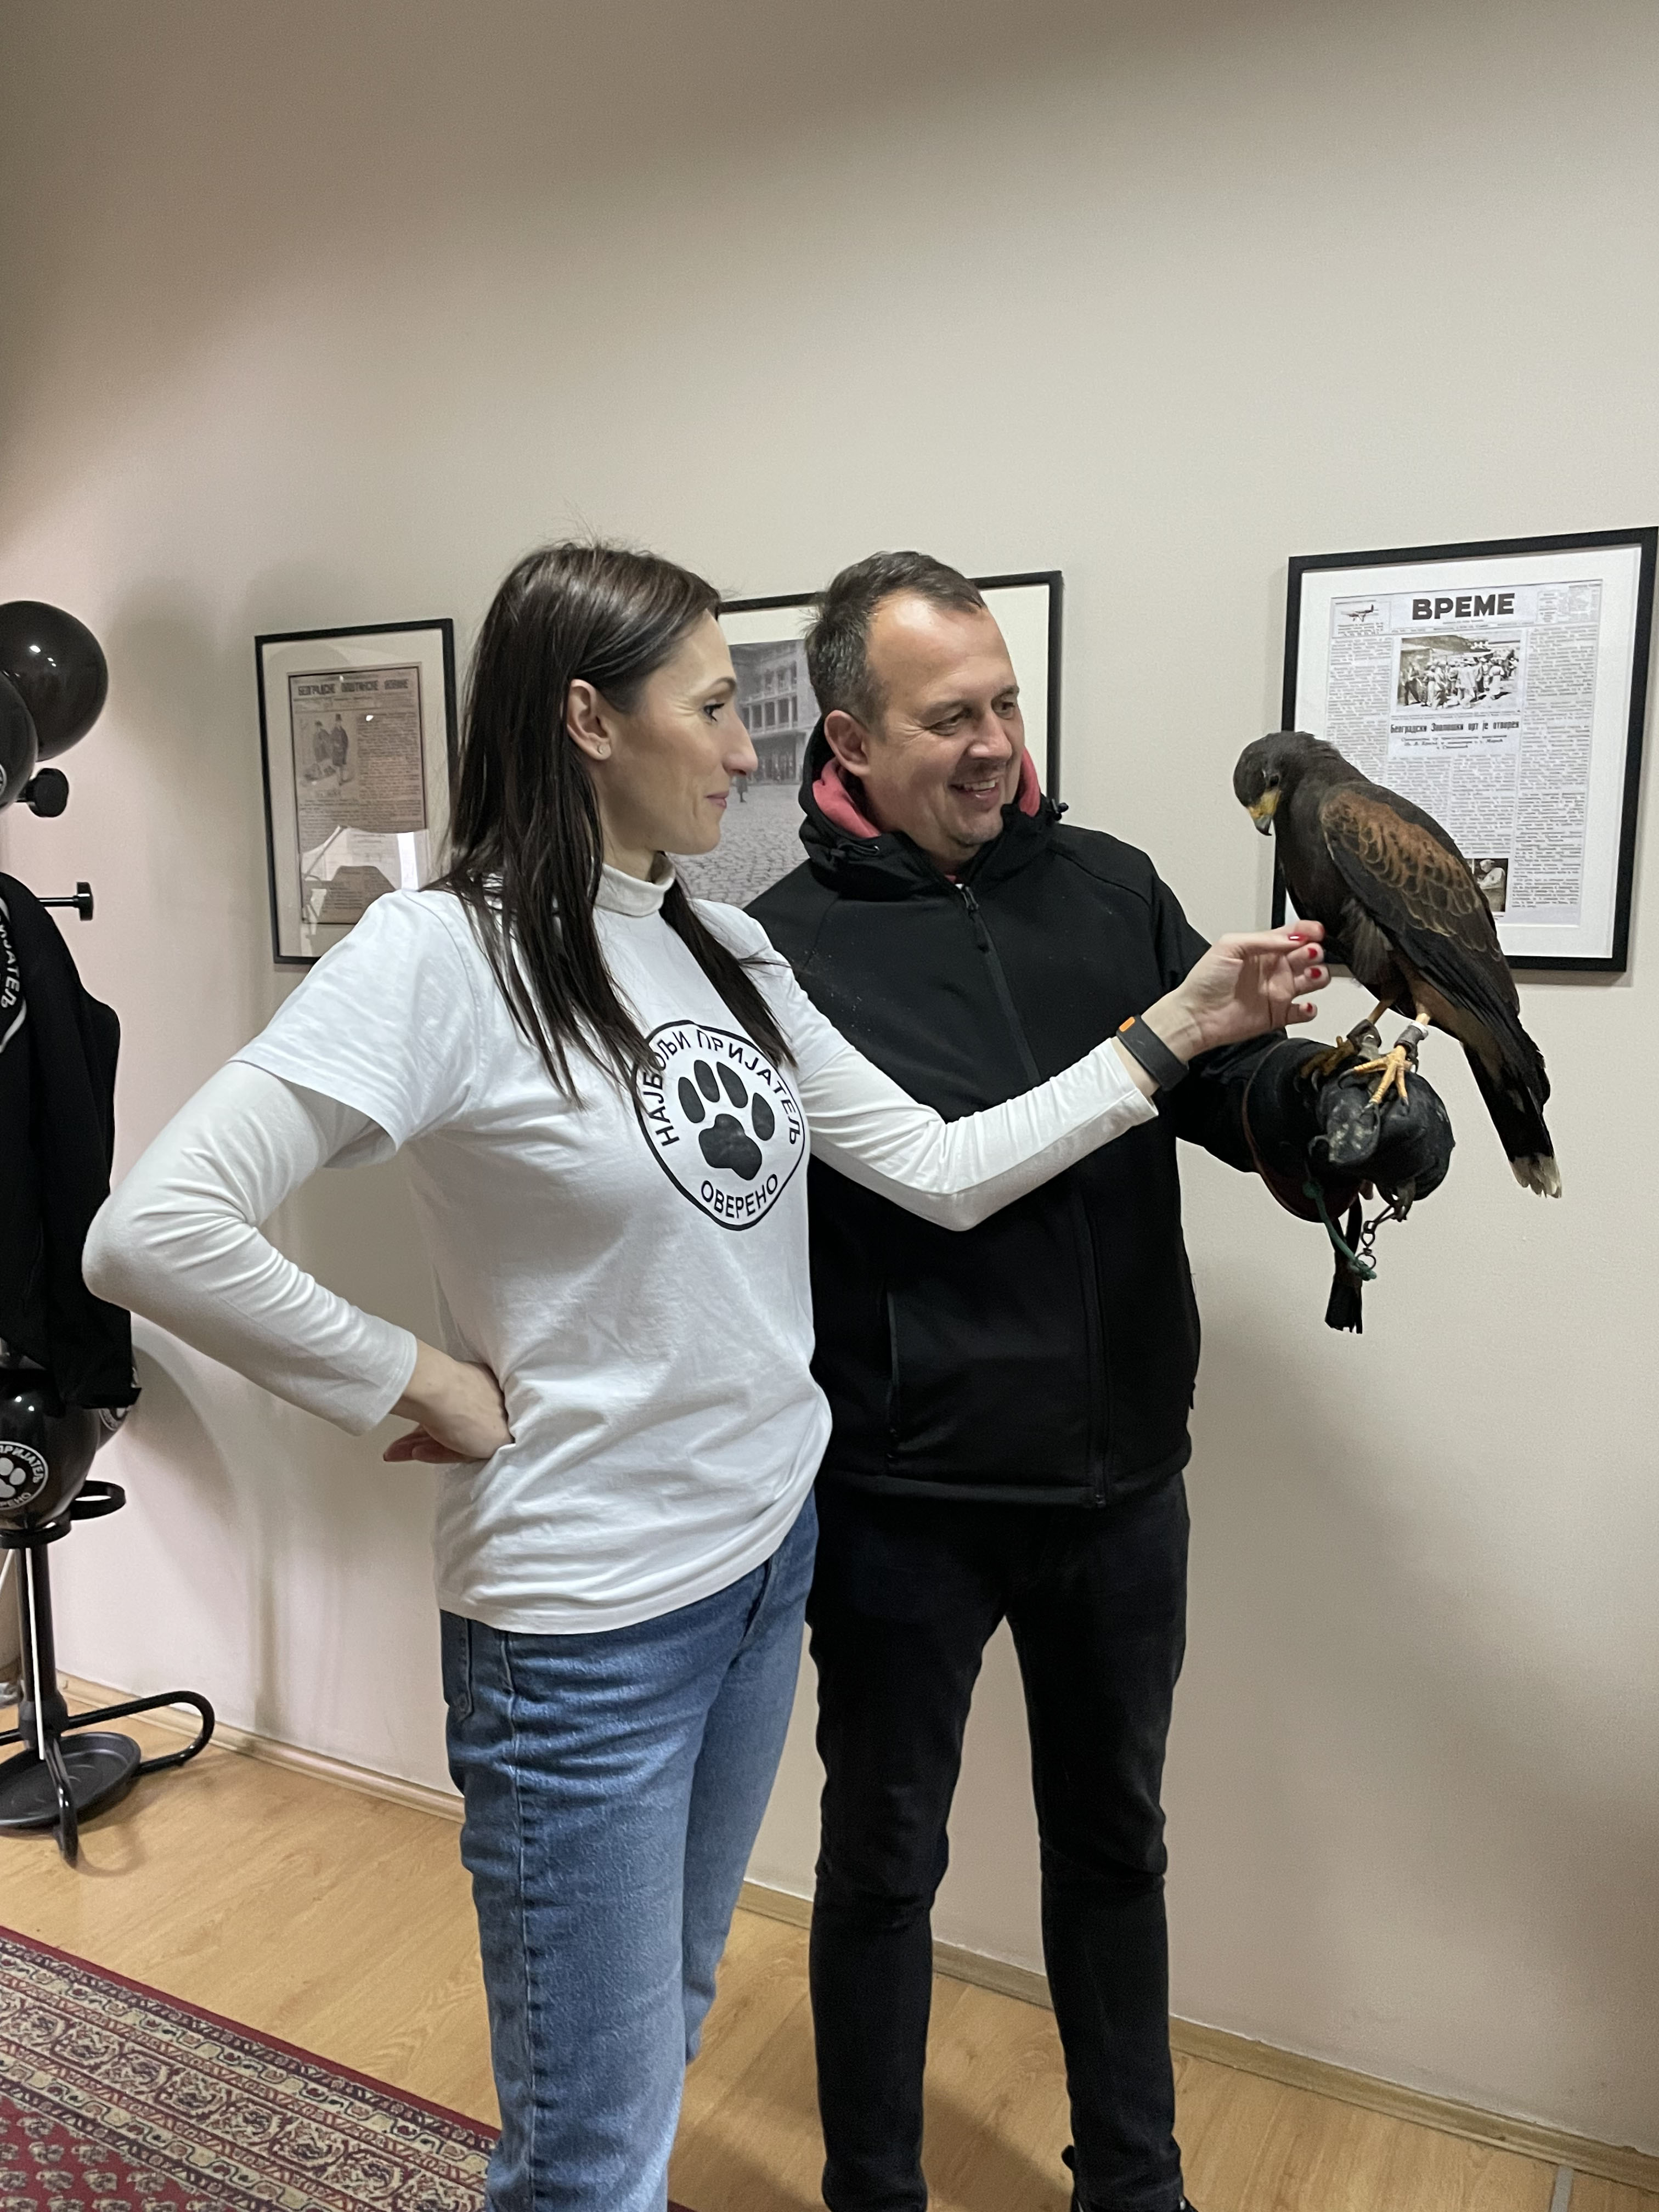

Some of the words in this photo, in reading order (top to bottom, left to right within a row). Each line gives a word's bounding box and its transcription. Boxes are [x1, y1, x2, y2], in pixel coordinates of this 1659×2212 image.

[1412, 592, 1515, 620] ВРЕМЕ
[696, 1029, 802, 1145] ПРИЈАТЕЉ
[701, 1173, 778, 1219] ОВЕРЕНО
